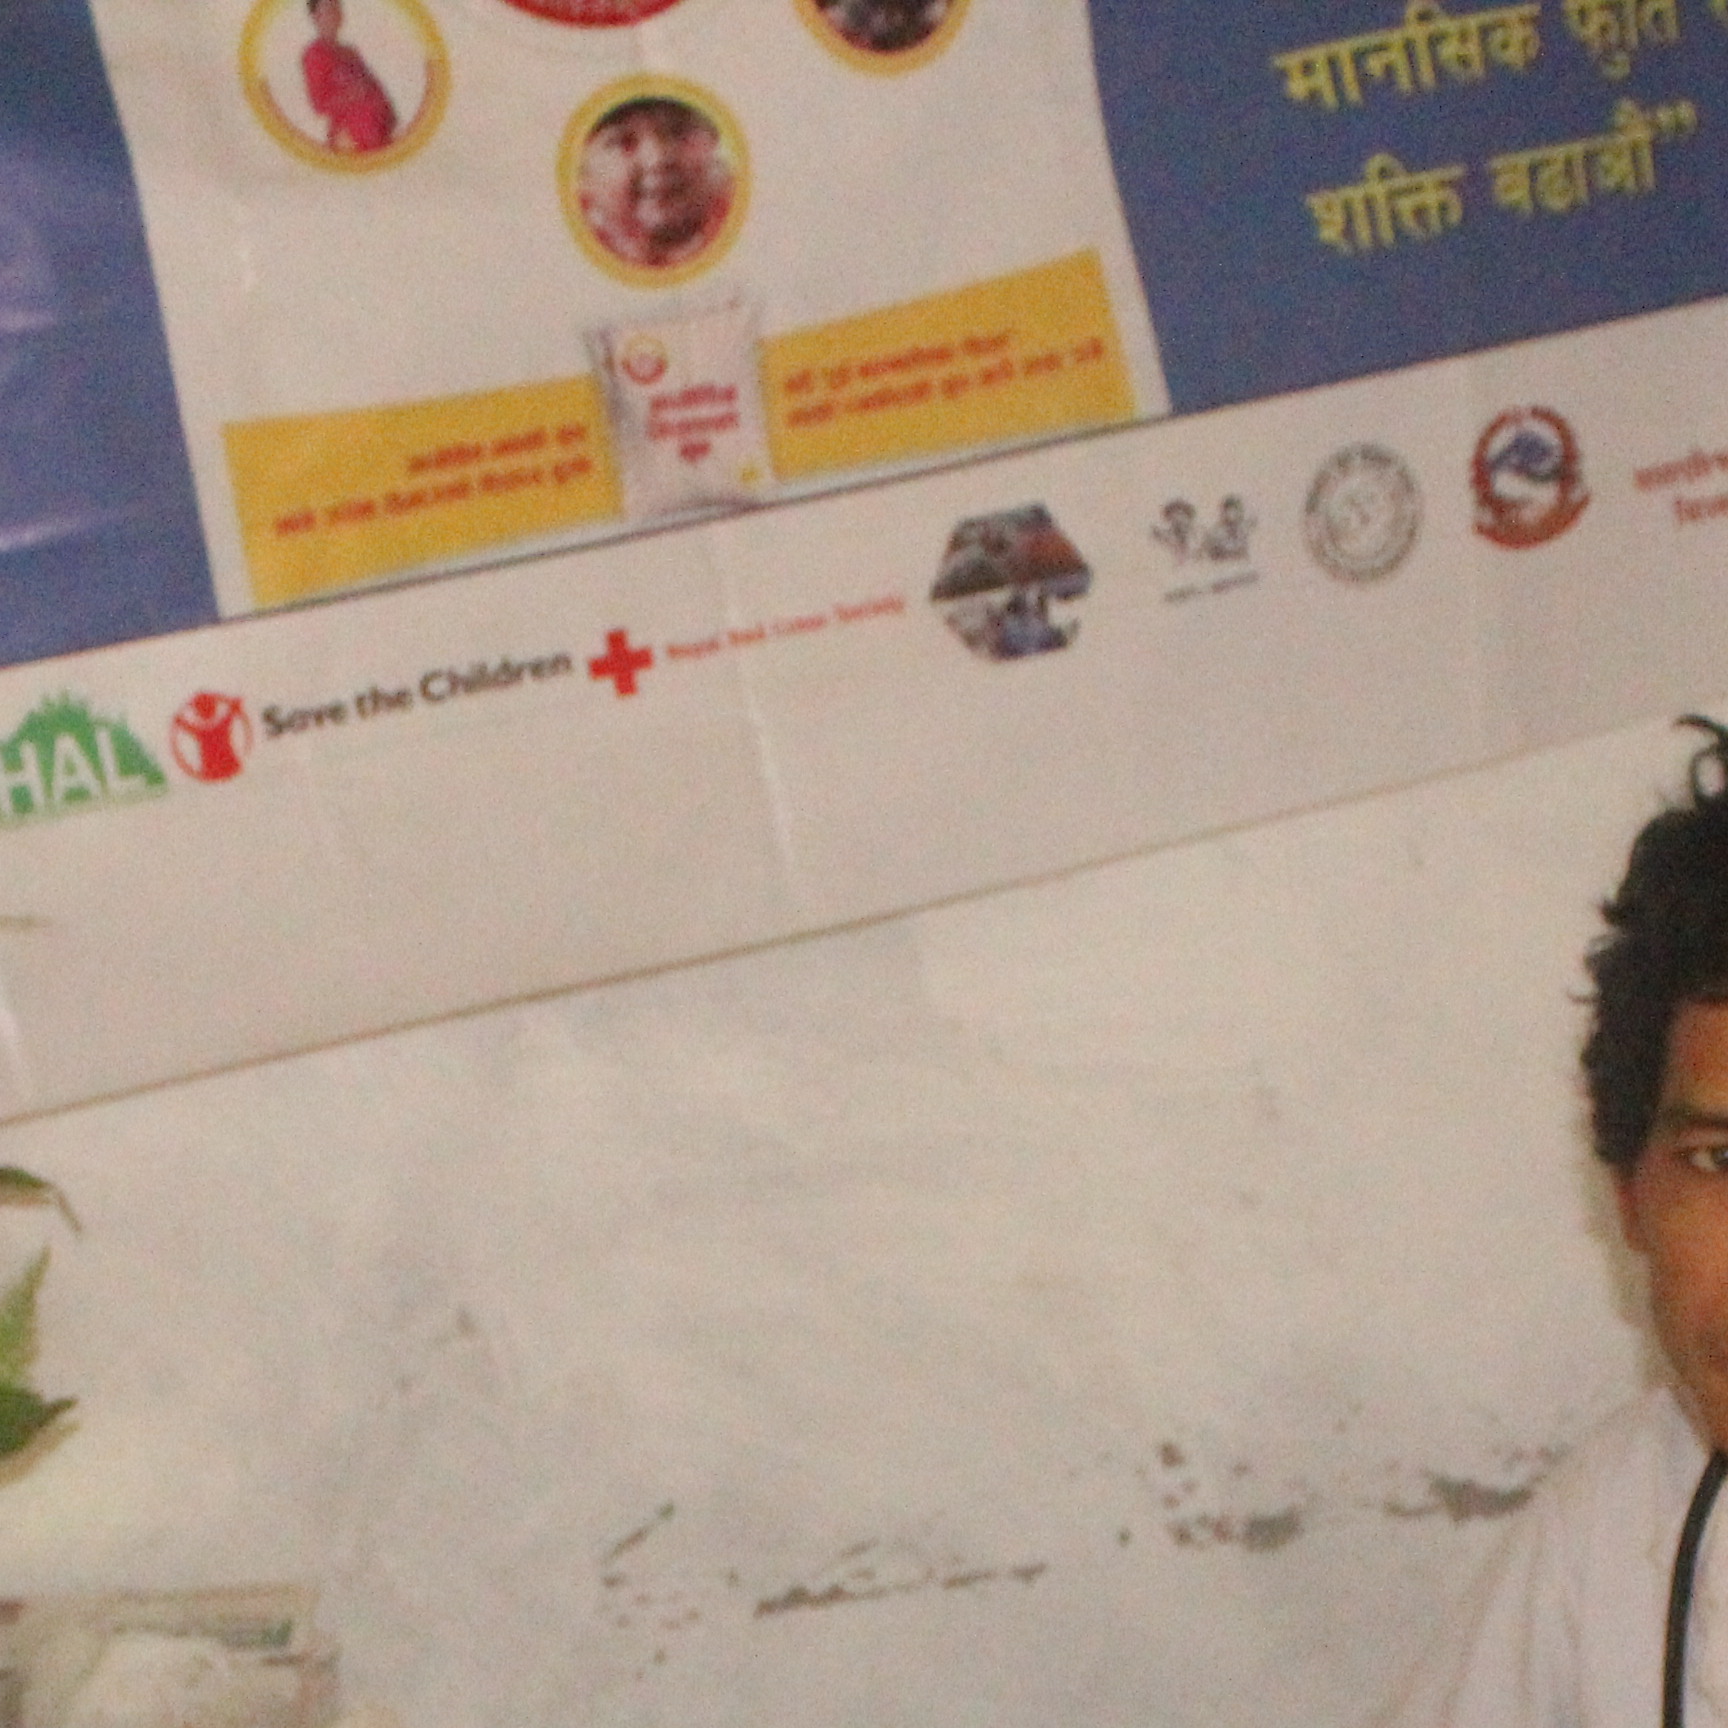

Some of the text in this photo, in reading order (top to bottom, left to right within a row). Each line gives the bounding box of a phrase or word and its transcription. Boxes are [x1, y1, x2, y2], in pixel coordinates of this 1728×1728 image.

[262, 648, 572, 739] Save the Children
